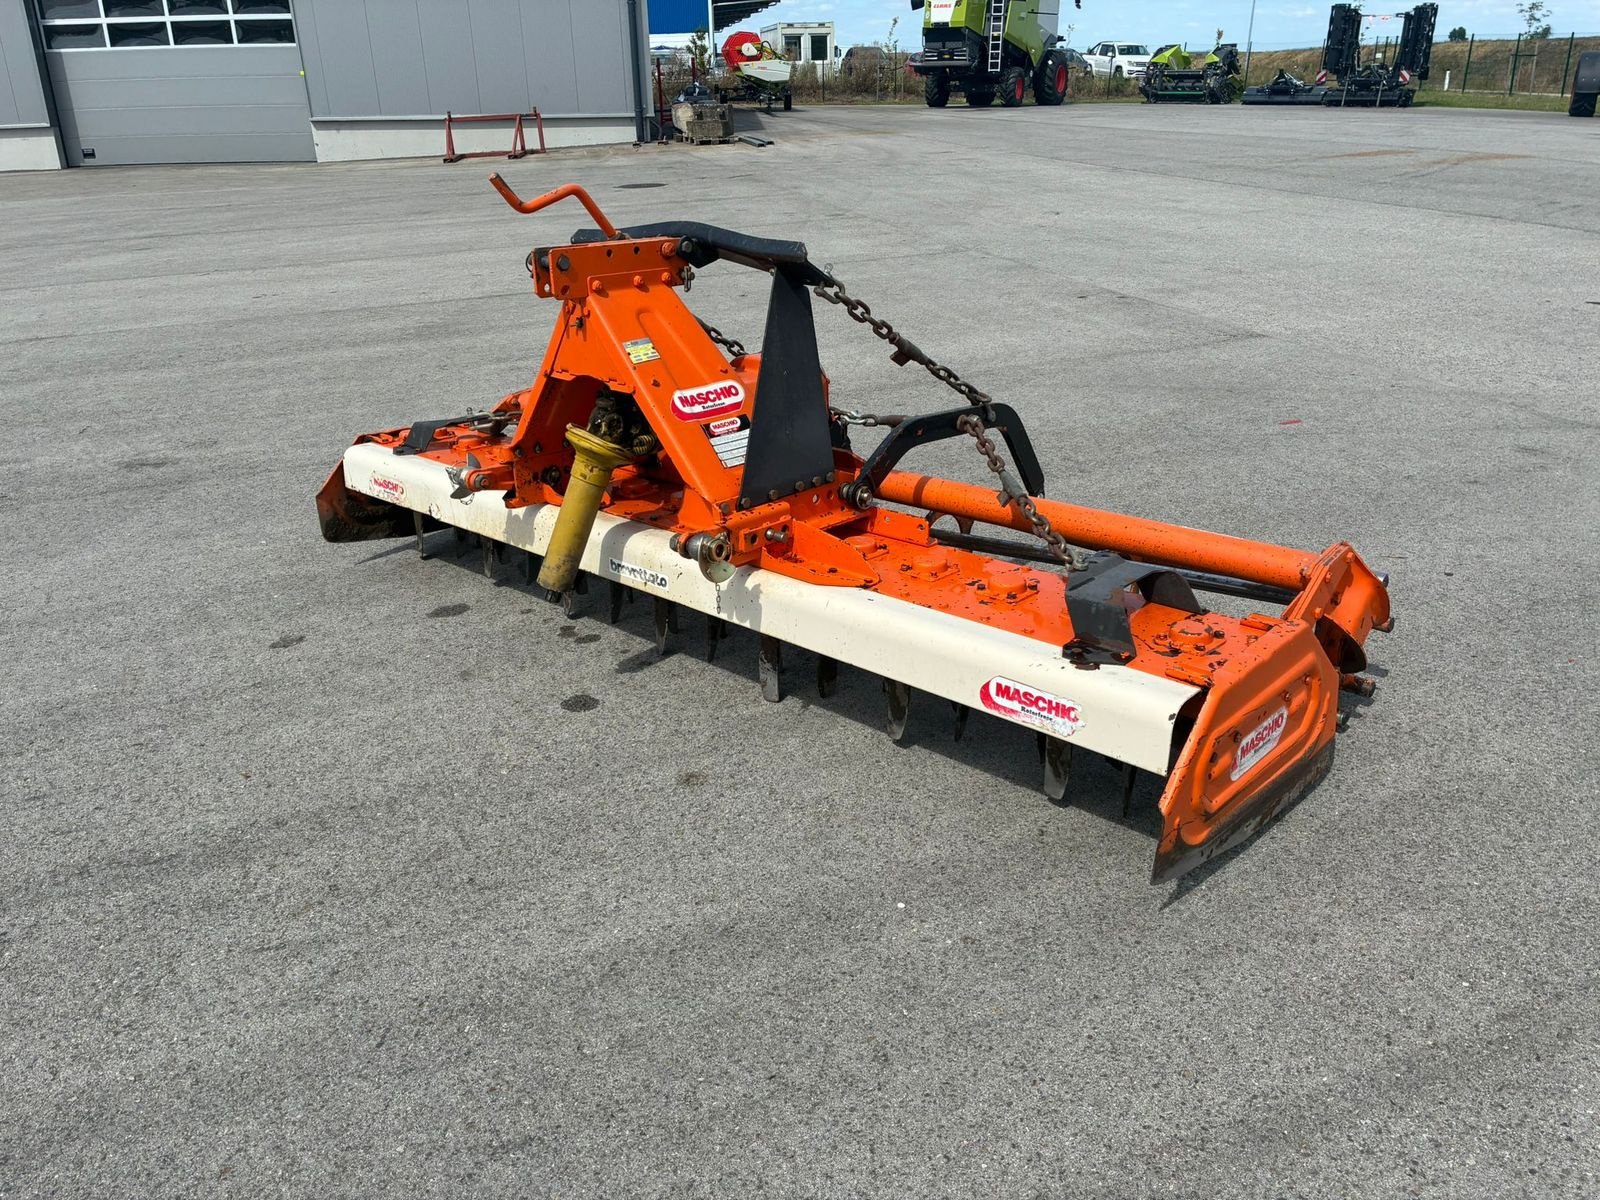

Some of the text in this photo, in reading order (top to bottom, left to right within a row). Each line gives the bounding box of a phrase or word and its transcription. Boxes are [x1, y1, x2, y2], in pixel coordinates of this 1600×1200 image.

[678, 384, 740, 408] MASCHIO
[711, 418, 738, 430] MASCHIO
[1240, 712, 1285, 760] MASCHIO
